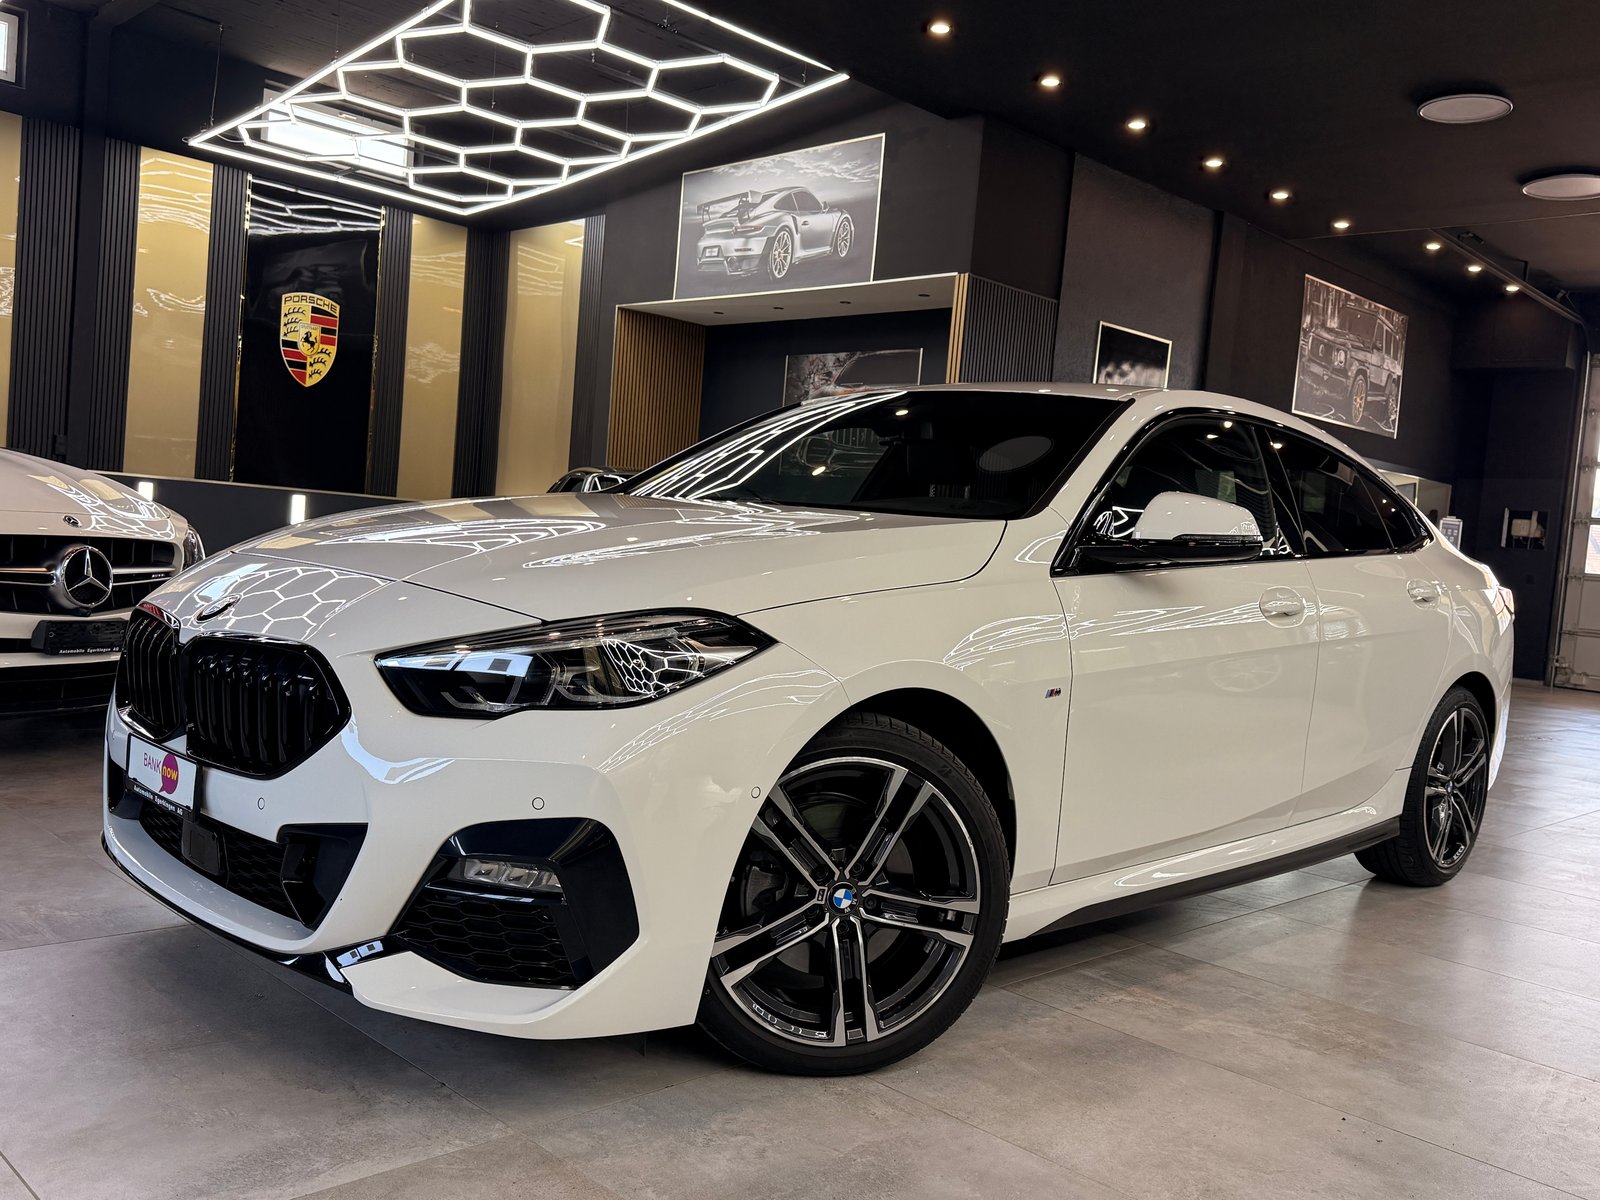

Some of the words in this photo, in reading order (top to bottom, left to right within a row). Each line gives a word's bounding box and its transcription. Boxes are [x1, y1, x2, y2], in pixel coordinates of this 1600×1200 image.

[284, 295, 338, 314] PORSCHE
[143, 752, 161, 774] BANK
[162, 766, 178, 780] now
[133, 784, 153, 800] Automobile
[177, 807, 183, 815] AG
